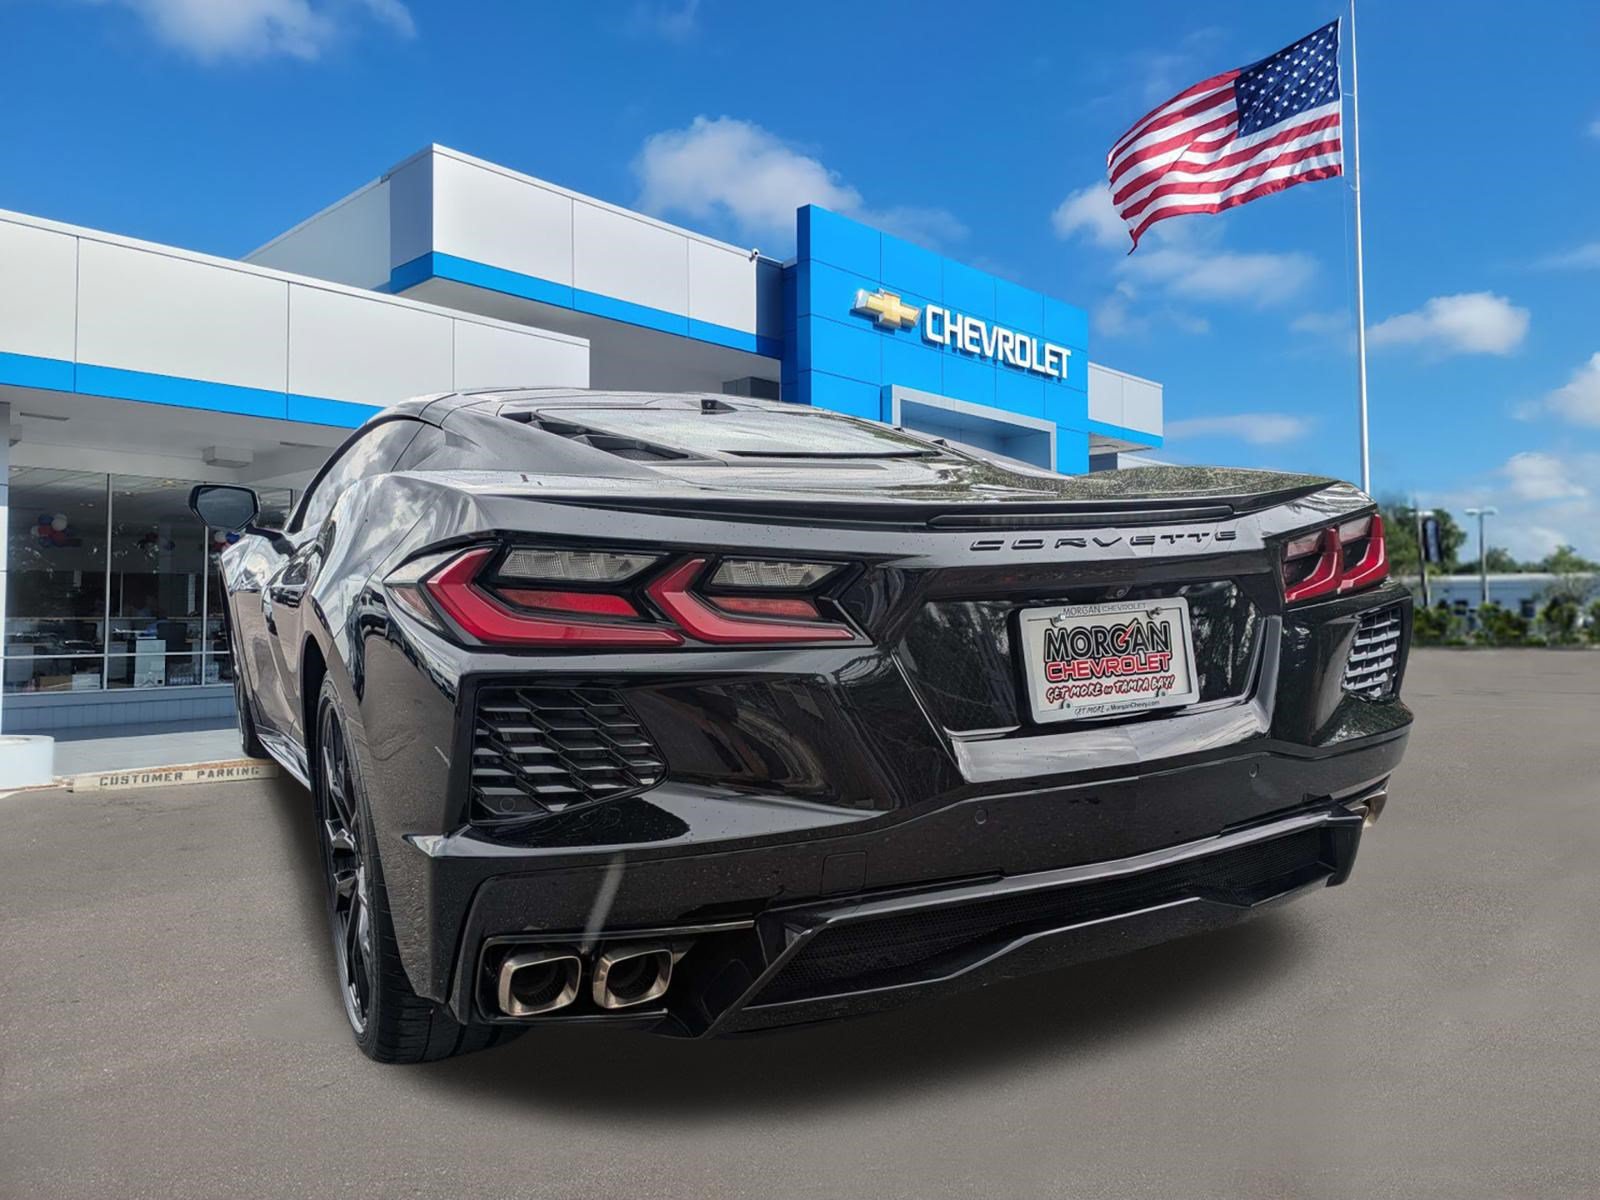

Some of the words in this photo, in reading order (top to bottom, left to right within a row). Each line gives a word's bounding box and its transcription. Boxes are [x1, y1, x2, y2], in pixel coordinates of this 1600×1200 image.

[925, 304, 1072, 379] CHEVROLET
[969, 530, 1237, 551] CORVETTE
[1063, 605, 1100, 616] MORGAN
[1102, 602, 1146, 612] CHEVROLET
[1044, 620, 1172, 662] MORGAN
[1045, 652, 1172, 682] CHEVROLET
[1046, 685, 1069, 703] GET
[1069, 682, 1103, 699] MORE
[1114, 676, 1150, 694] TAMPA
[99, 771, 184, 786] CUSTOMER
[196, 766, 260, 779] PARKING
